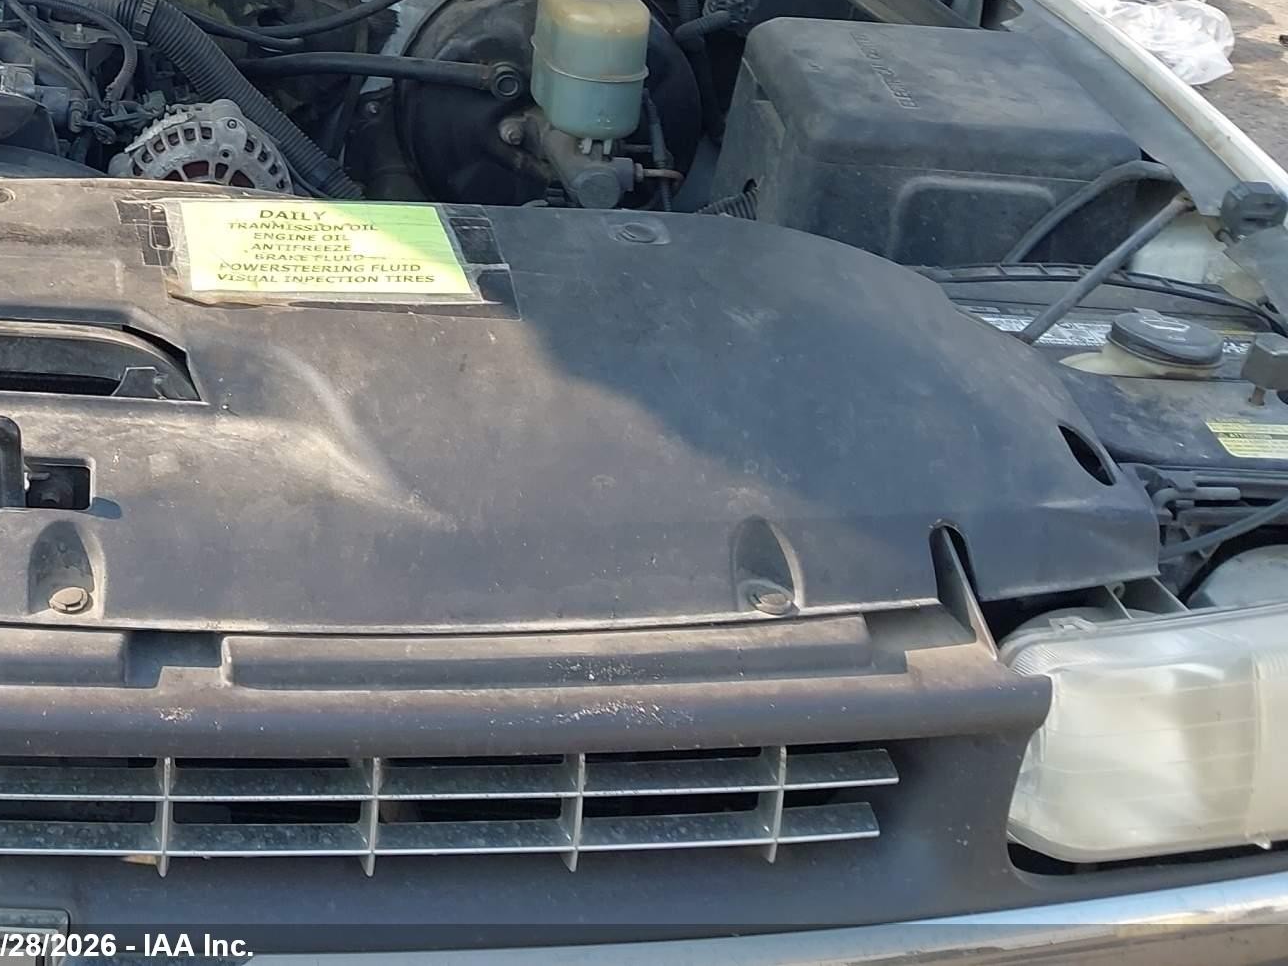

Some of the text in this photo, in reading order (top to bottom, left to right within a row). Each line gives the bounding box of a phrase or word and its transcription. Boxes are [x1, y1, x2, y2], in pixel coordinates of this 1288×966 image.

[259, 209, 327, 222] DAILY
[228, 221, 378, 232] TRANMISSION OIL
[253, 232, 351, 242] ENGINE OIL
[251, 242, 352, 252] ANTIFREEZE
[255, 253, 366, 263] BRAKE FLUID
[219, 262, 422, 273] POWERSTEERING FLUID
[218, 273, 436, 283] VISUAL INPECTION TIRES
